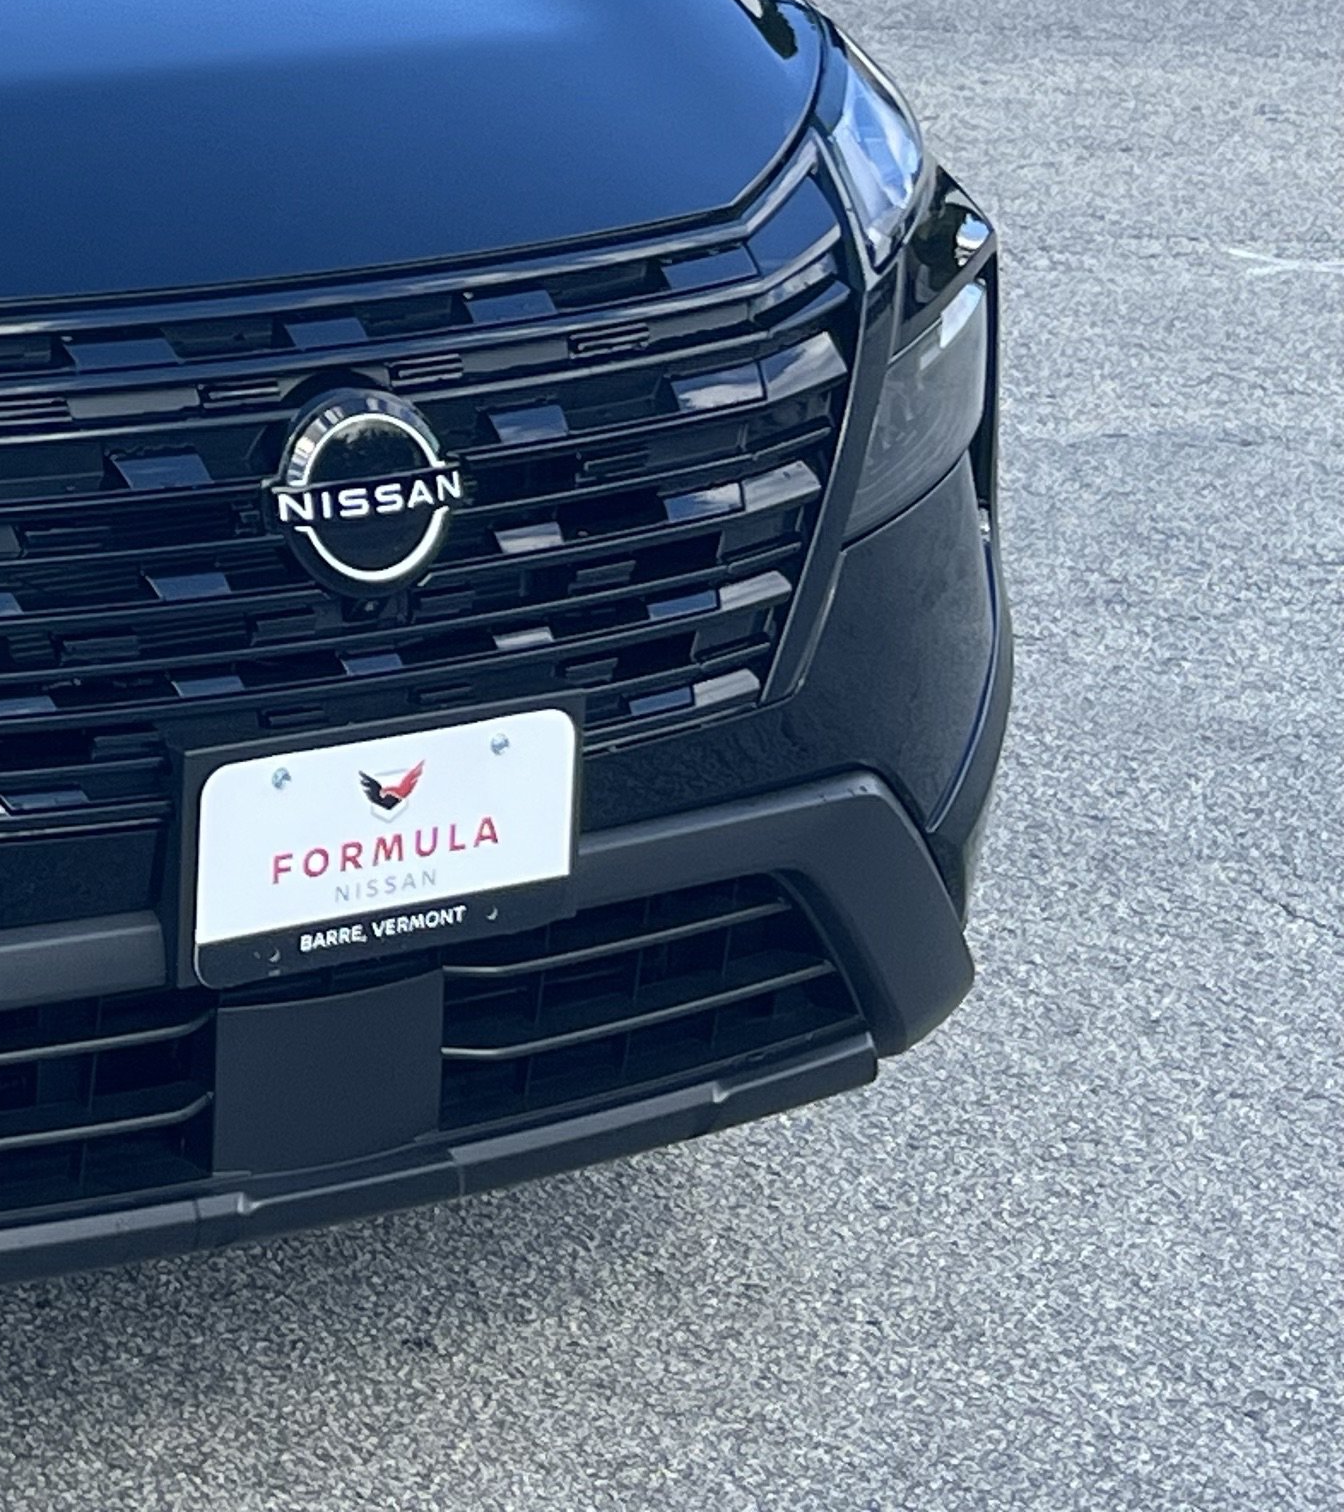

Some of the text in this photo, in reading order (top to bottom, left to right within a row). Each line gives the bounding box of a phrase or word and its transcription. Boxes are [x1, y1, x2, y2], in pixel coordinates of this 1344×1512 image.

[278, 471, 461, 522] NISSAN
[272, 816, 499, 885] FORMULA
[335, 869, 437, 903] NISSAN
[299, 905, 467, 953] BARRE, VERMONT
